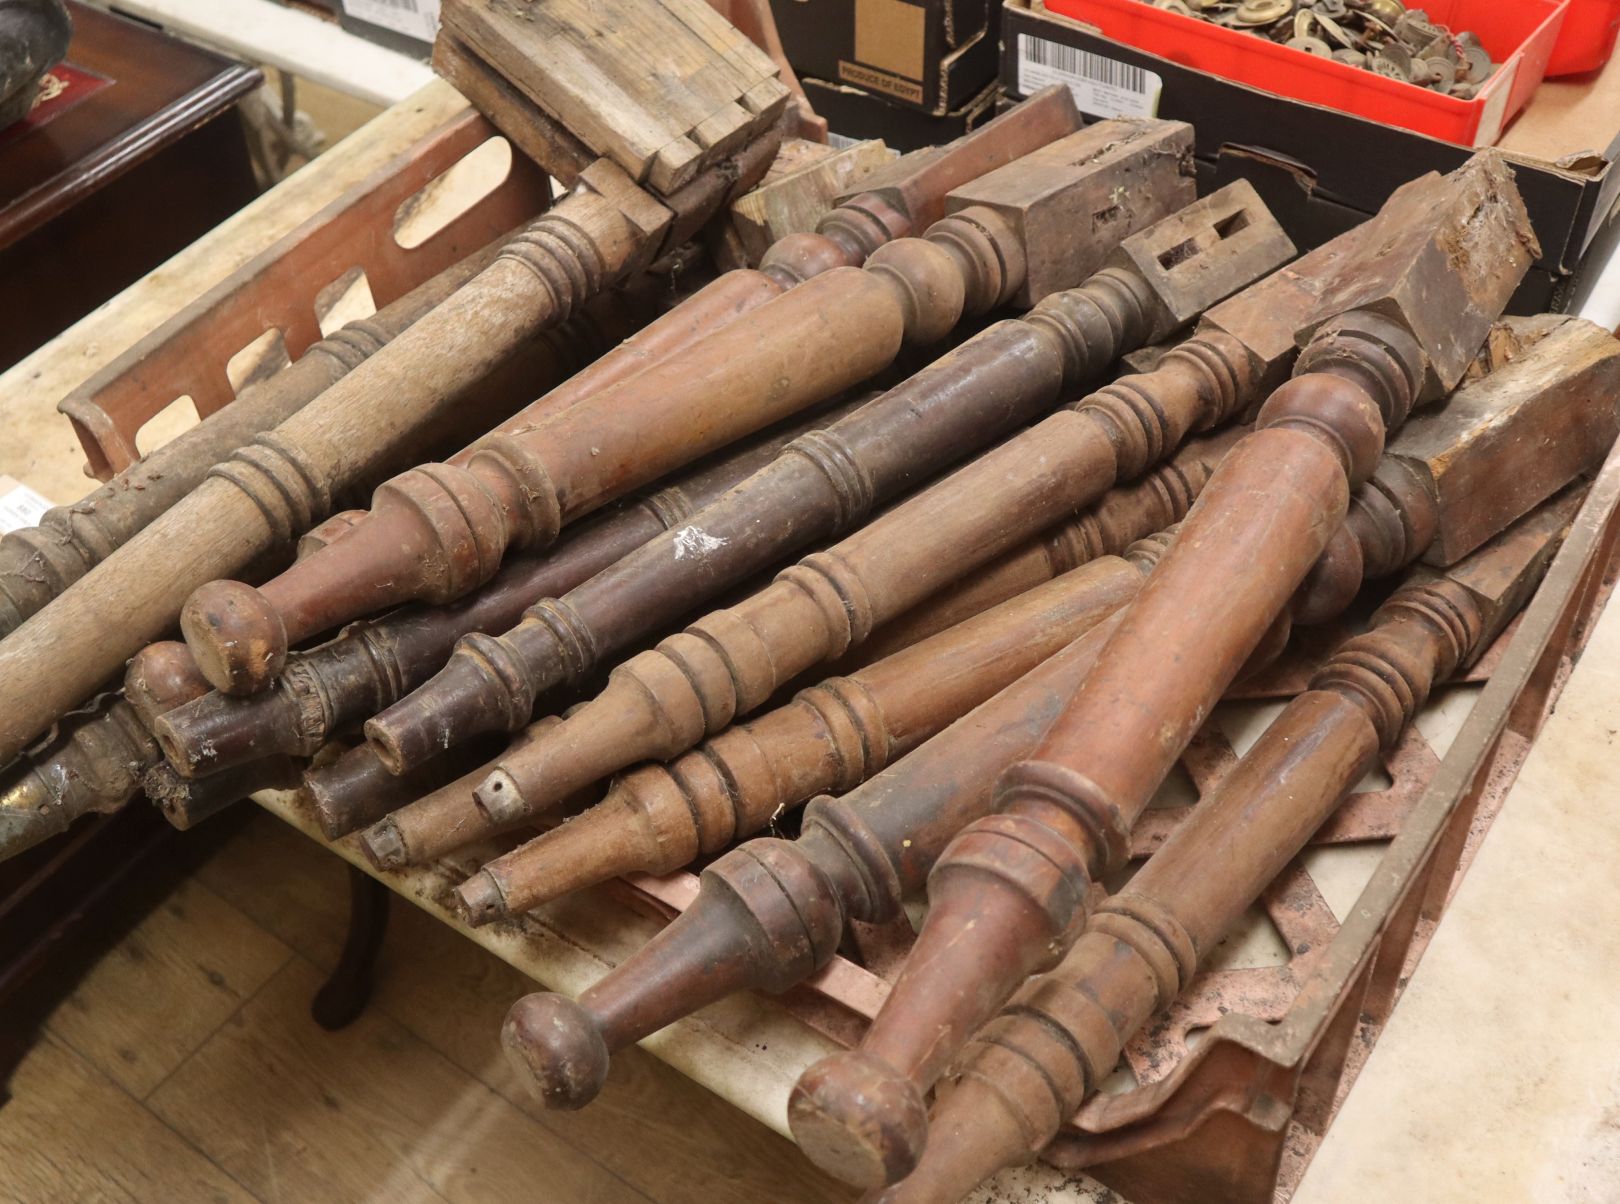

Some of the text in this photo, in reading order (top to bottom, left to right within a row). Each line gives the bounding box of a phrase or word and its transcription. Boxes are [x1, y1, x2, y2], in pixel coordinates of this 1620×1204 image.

[842, 65, 920, 99] PRODUCE OF EGYPT
